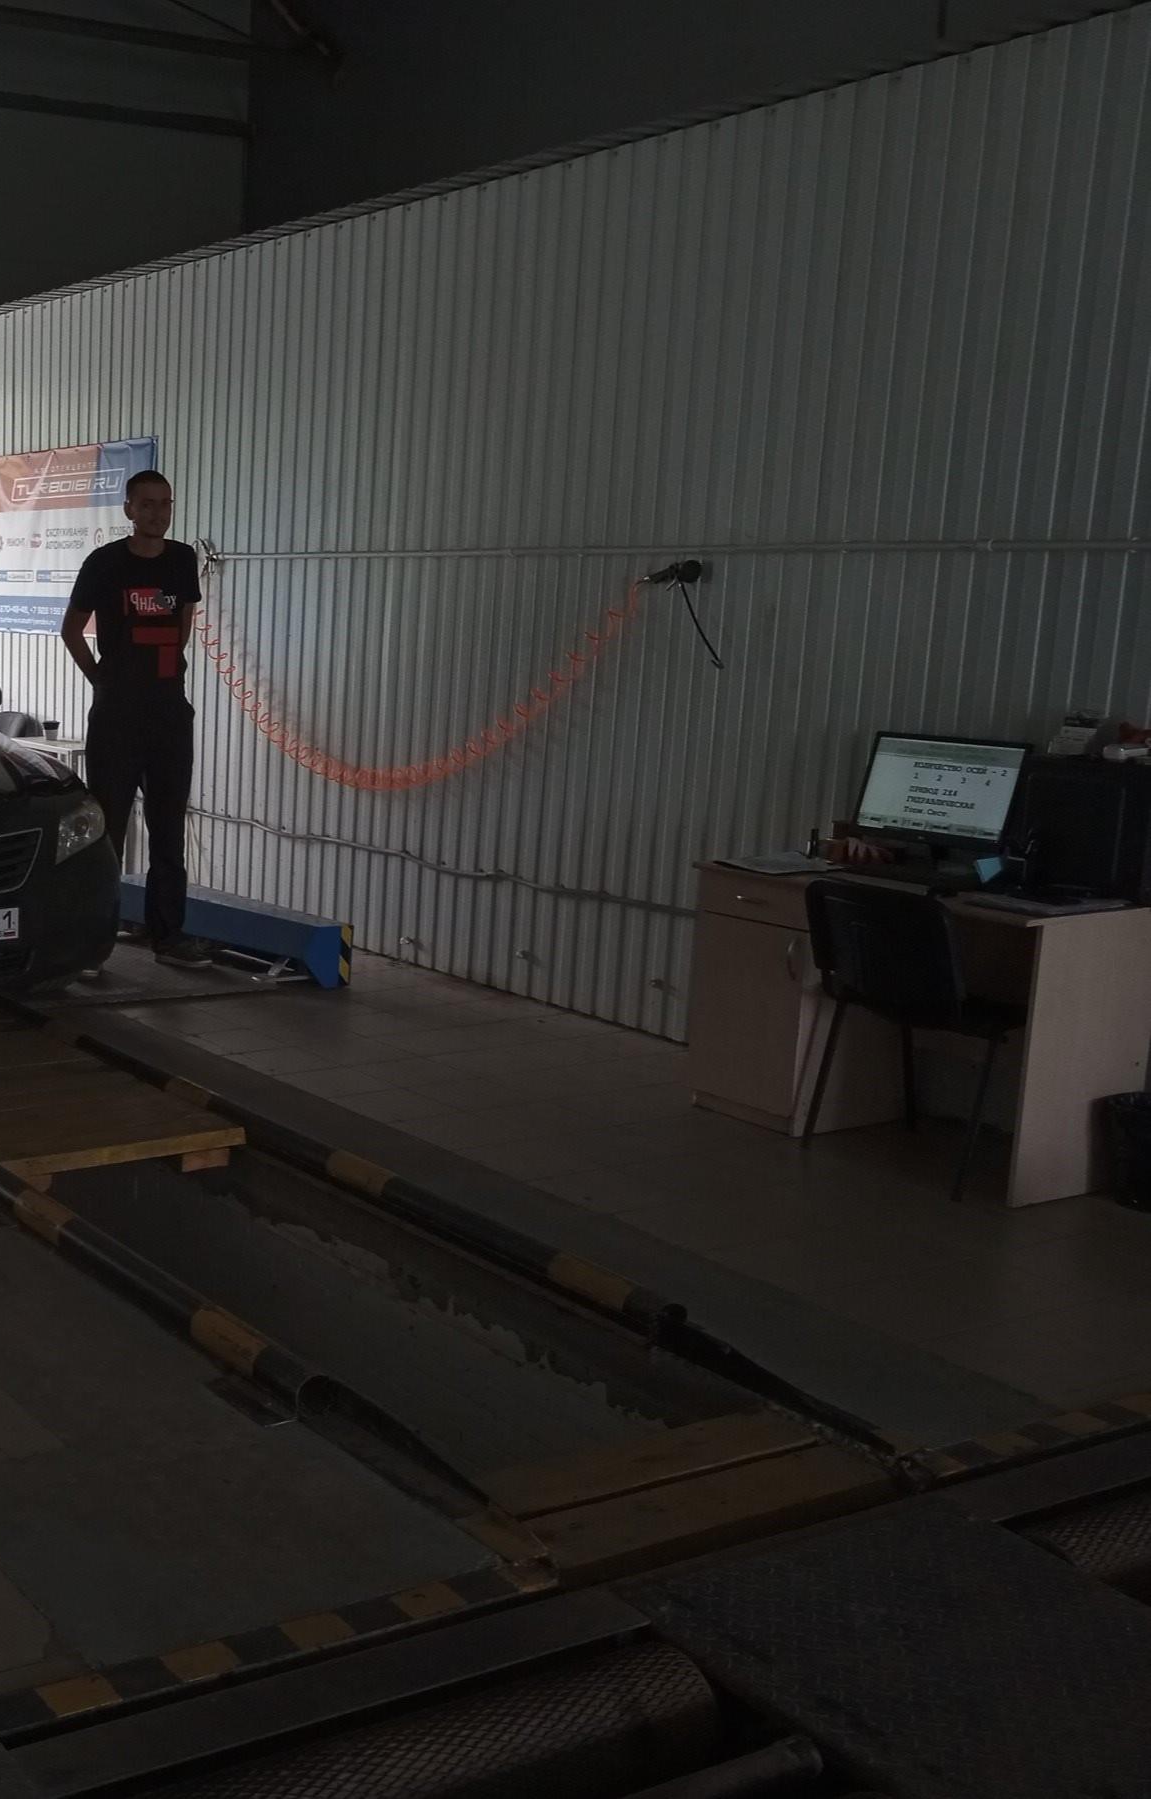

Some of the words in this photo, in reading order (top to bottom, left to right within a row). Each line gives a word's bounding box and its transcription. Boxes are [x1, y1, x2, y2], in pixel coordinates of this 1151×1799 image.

[1000, 769, 1008, 777] 2
[936, 774, 943, 782] 2
[960, 776, 967, 784] 3
